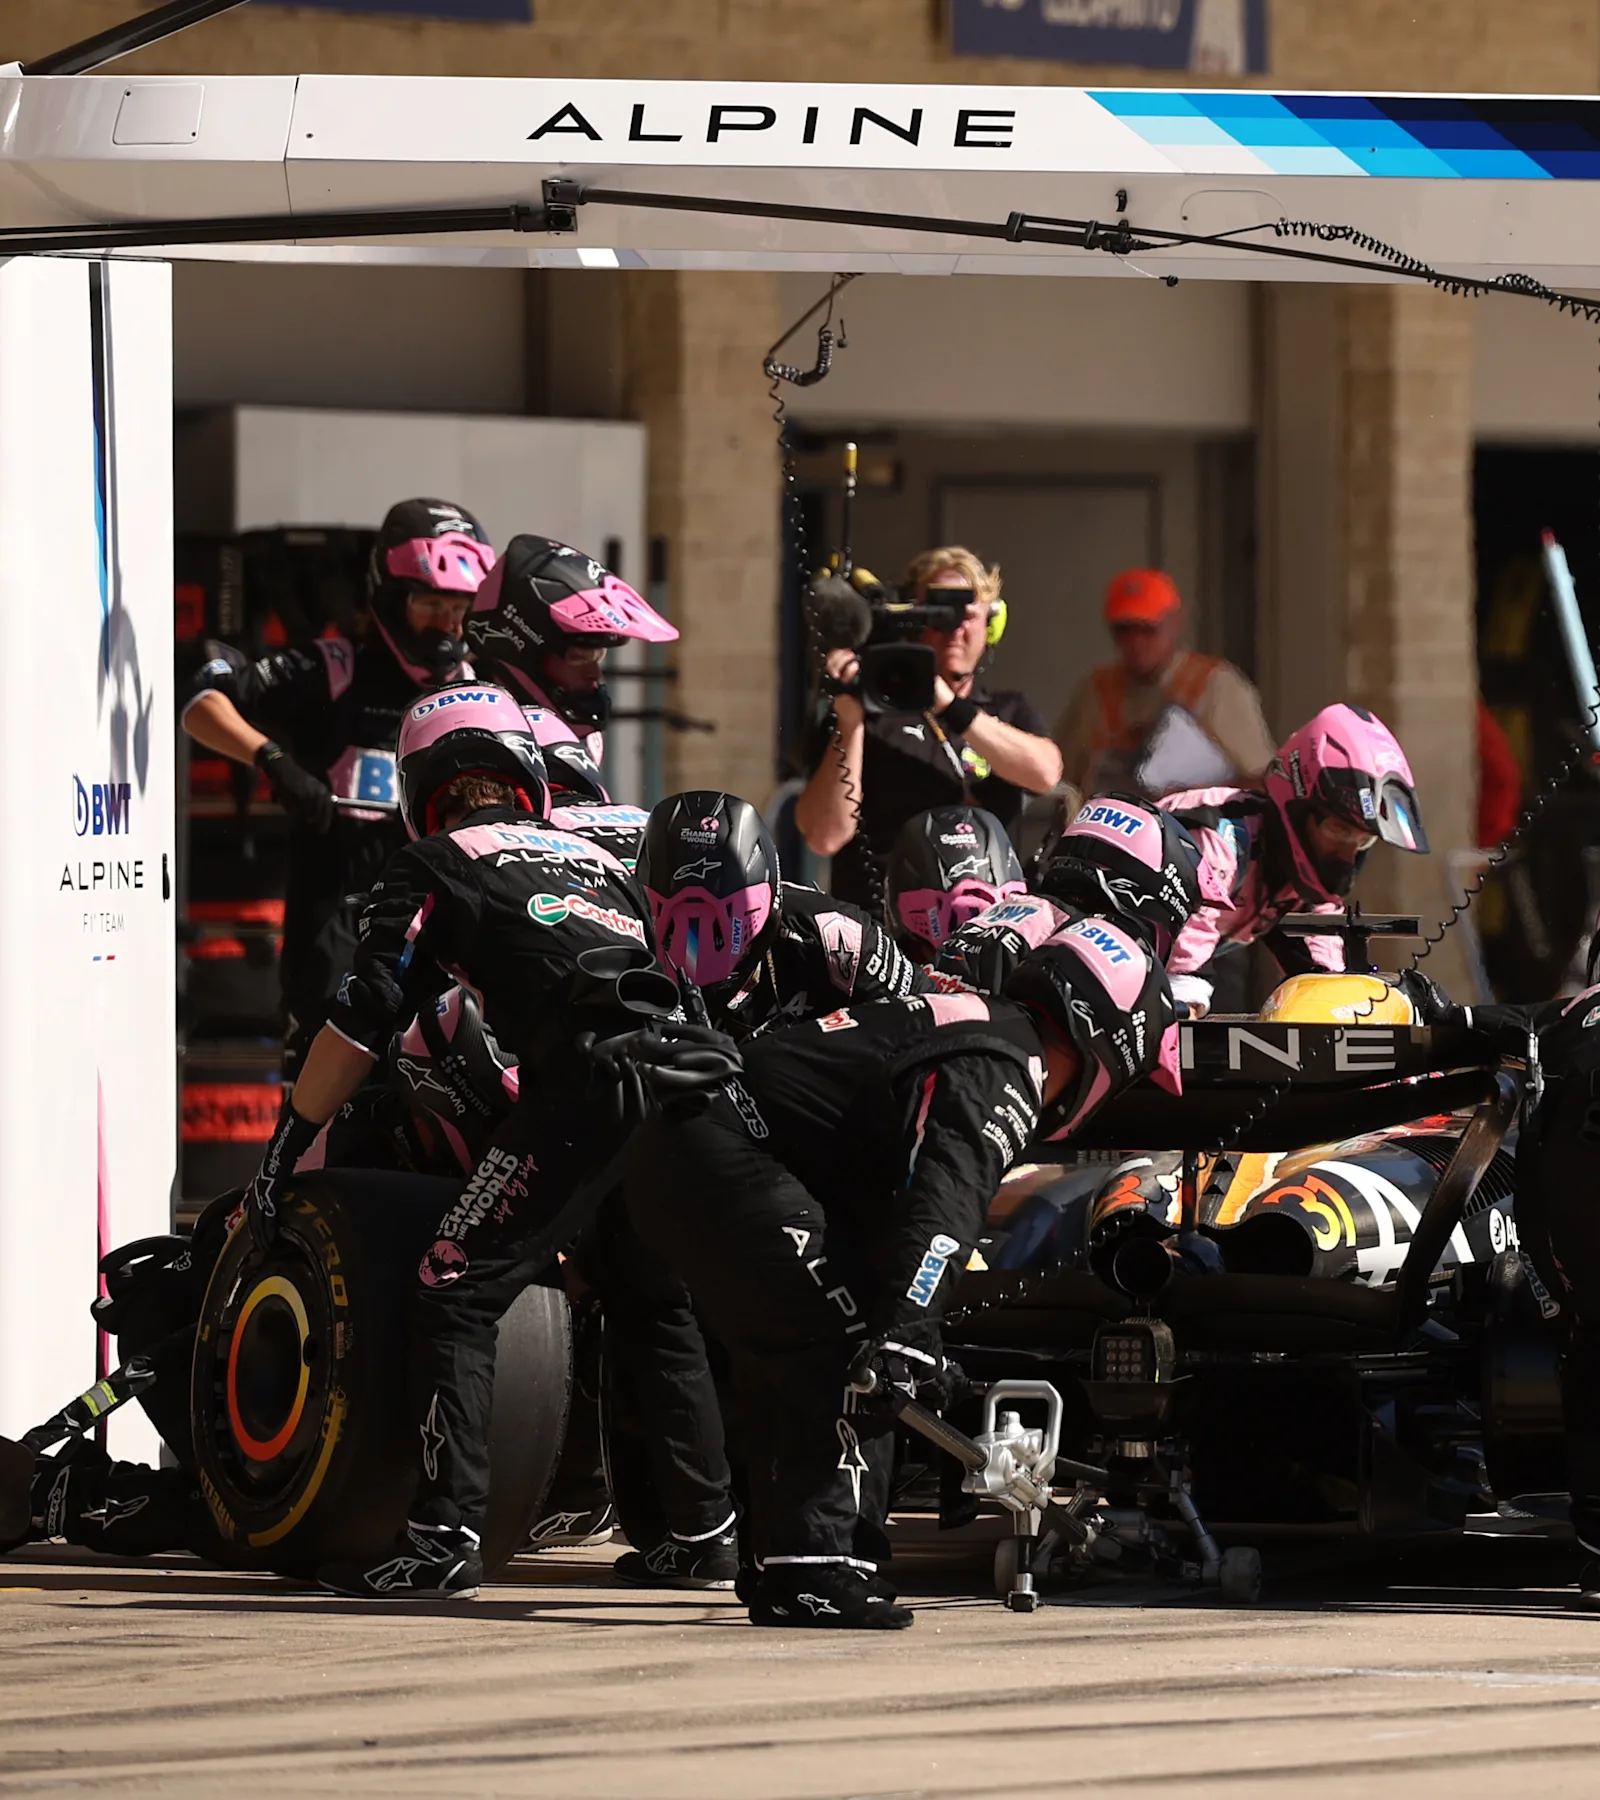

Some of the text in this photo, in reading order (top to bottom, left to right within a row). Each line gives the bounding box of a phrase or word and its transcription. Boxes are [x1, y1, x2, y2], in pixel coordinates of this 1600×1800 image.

[525, 101, 1016, 149] ALPINE
[511, 611, 545, 647] shamir
[436, 690, 500, 709] BWT
[91, 782, 132, 836] BWT
[1089, 806, 1144, 837] BWT
[59, 860, 144, 892] ALPINE
[99, 911, 125, 933] TEAM
[564, 894, 647, 947] Castrol
[732, 918, 744, 946] BWT
[1080, 926, 1133, 967] BWT
[1180, 1025, 1397, 1072] INE
[443, 1084, 467, 1116] JAAQ
[452, 1071, 493, 1118] shamir
[443, 1146, 506, 1238] CHANGE
[456, 1154, 519, 1241] THE WORLD
[494, 1154, 539, 1223] sip by sip
[907, 1251, 948, 1308] BWT
